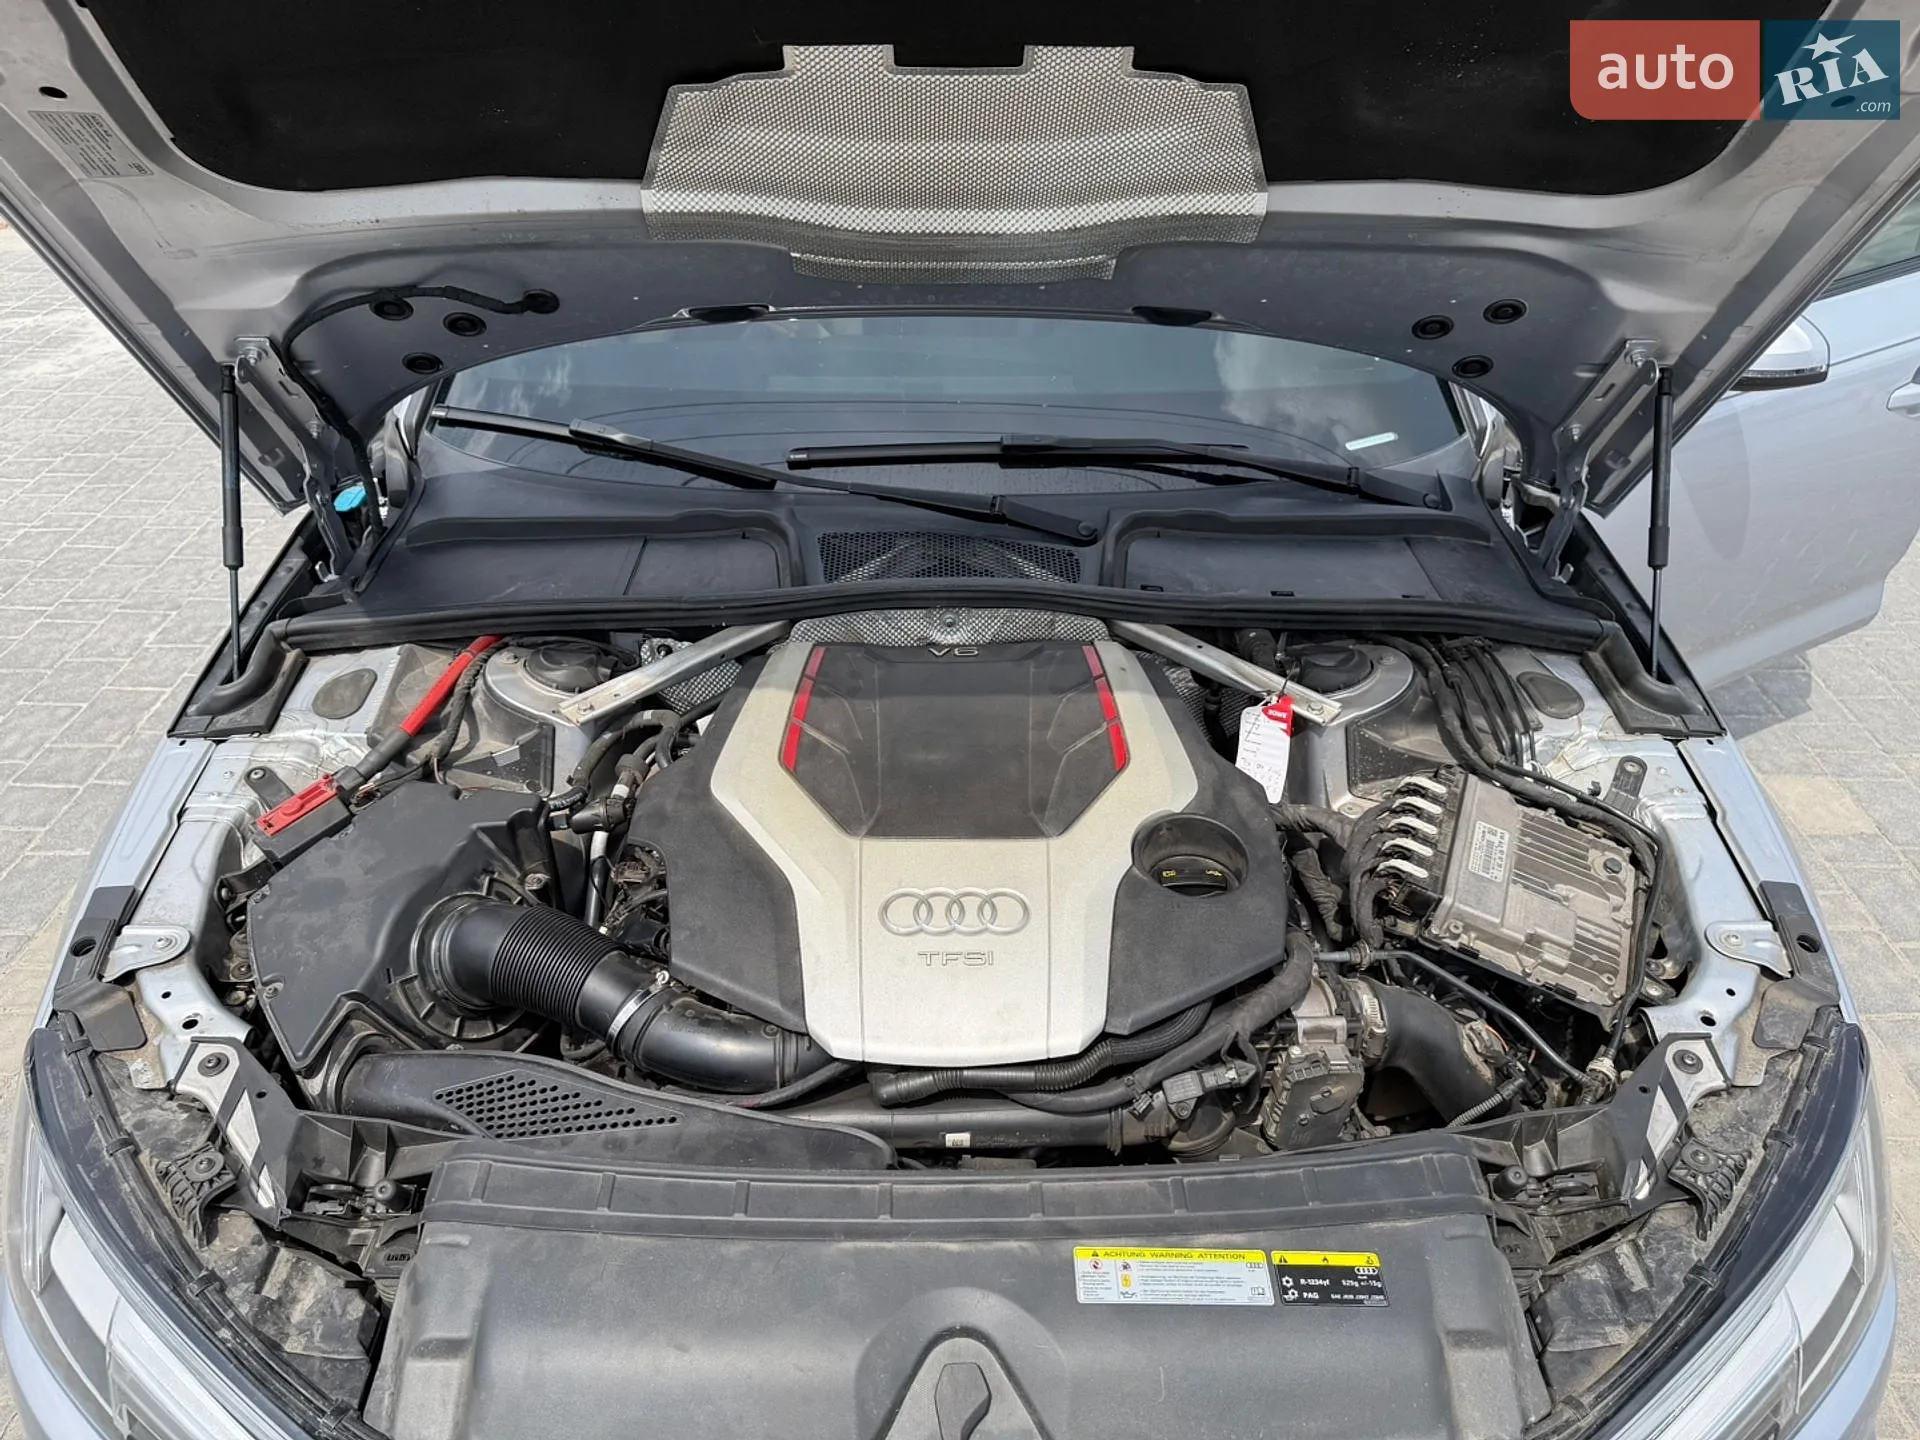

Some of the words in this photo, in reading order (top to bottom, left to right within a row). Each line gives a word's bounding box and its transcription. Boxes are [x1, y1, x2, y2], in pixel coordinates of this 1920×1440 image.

[928, 646, 979, 658] V6
[917, 950, 994, 966] TFSI
[1103, 1250, 1146, 1259] ACHTUNG
[1149, 1251, 1193, 1259] WARNING
[1197, 1252, 1246, 1260] ATTENTION
